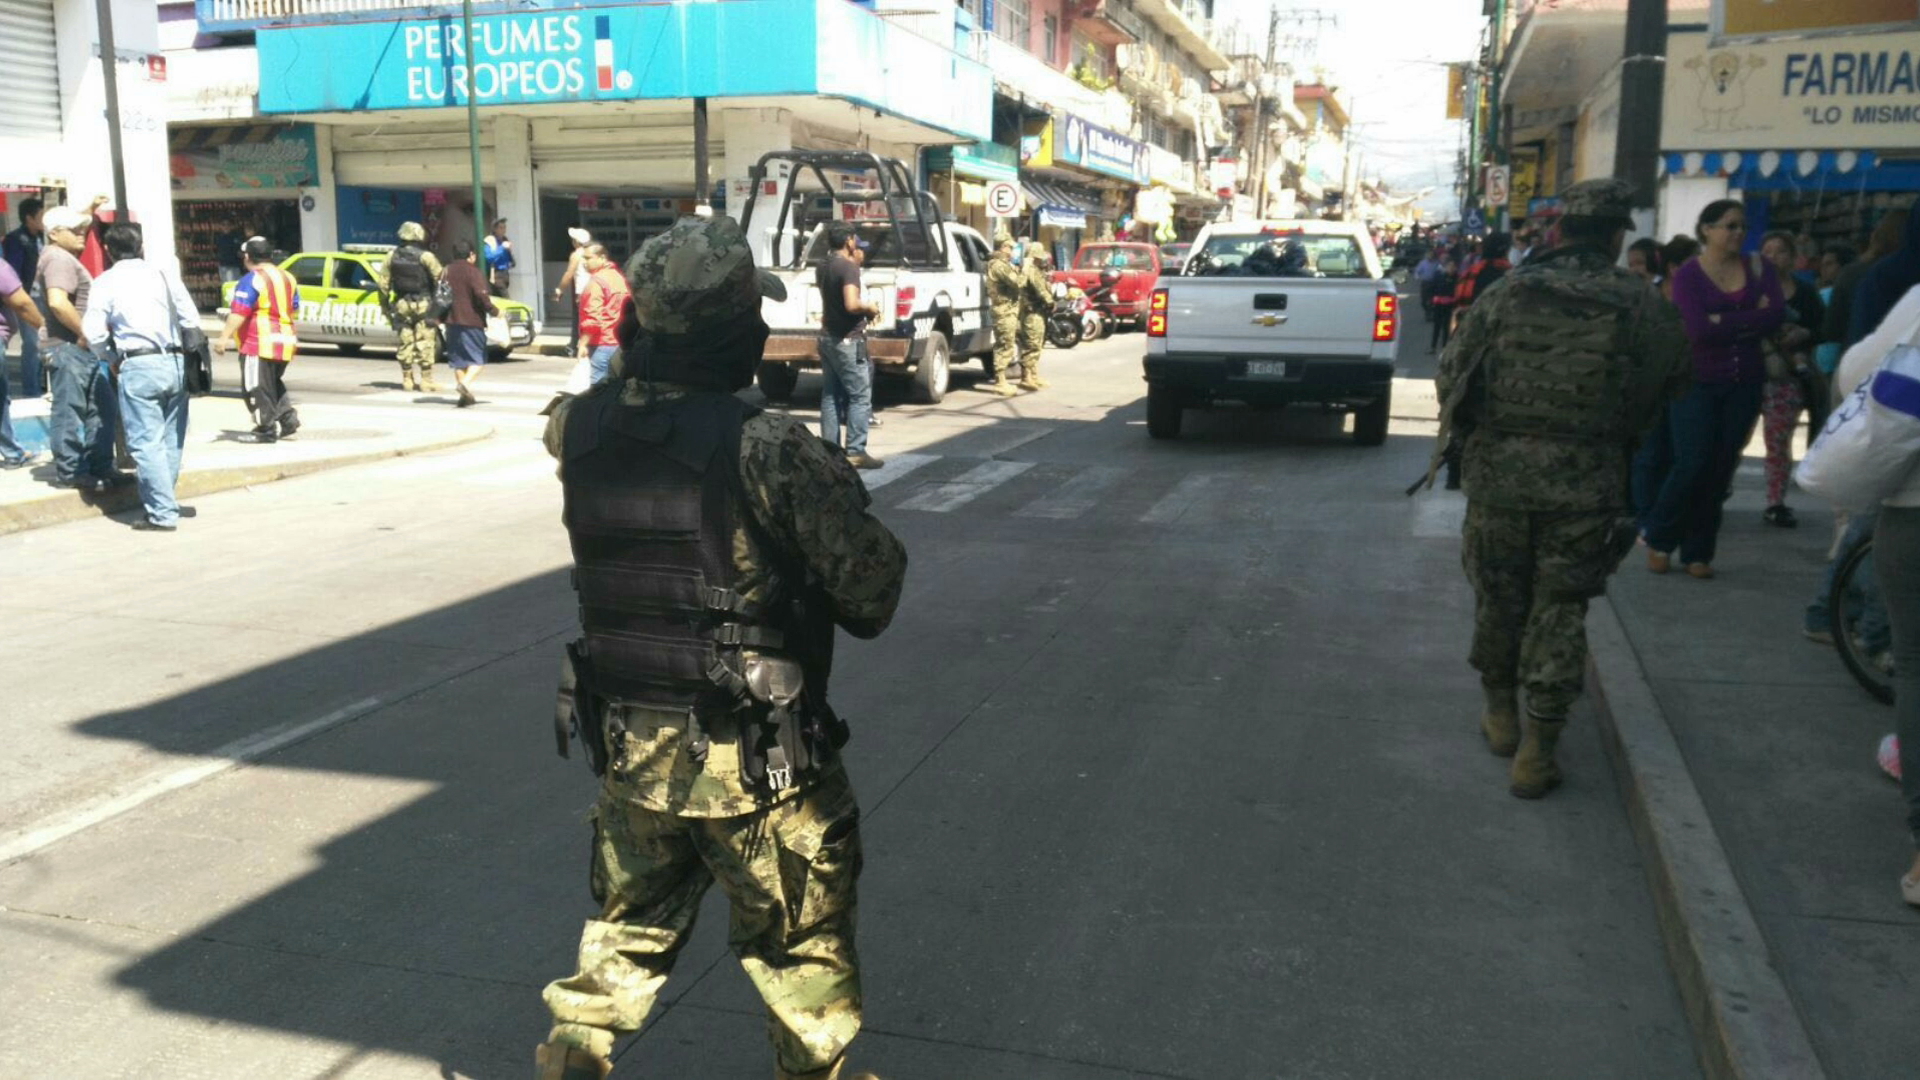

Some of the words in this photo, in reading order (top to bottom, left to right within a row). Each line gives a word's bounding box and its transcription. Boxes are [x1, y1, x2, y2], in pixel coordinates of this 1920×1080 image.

[405, 15, 582, 59] PERFUMES
[407, 57, 584, 100] EUROPEOS
[1783, 51, 1920, 95] FARMA
[997, 189, 1009, 208] E
